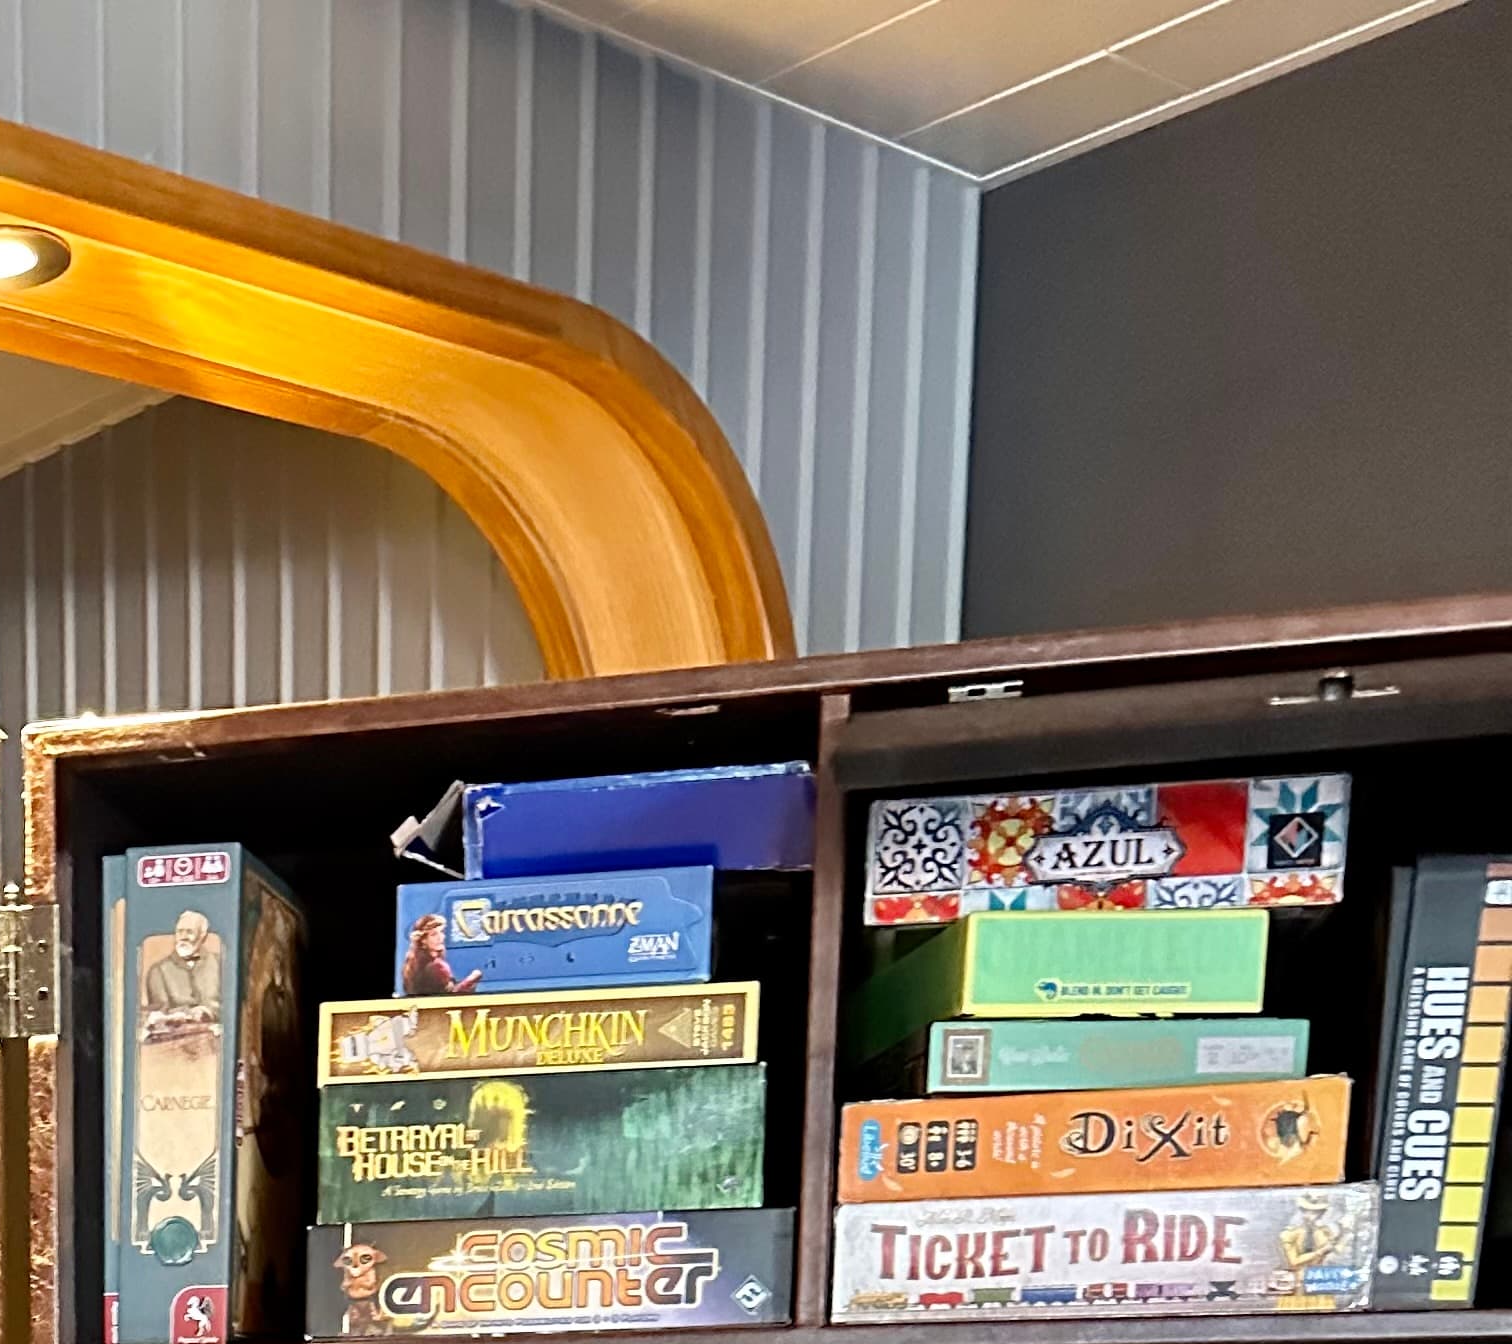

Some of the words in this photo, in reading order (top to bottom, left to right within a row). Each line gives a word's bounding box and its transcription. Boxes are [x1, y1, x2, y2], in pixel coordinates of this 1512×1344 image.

[1051, 838, 1154, 870] AZUL
[455, 900, 644, 940] Carcassonne
[1404, 978, 1424, 1036] GUESSING
[1417, 966, 1471, 1060] HUES
[445, 1008, 651, 1060] MUNCHKIN
[536, 1047, 605, 1066] DELUXE
[1400, 1039, 1417, 1075] GAME
[1418, 1064, 1447, 1104] AND
[337, 1123, 474, 1157] BETRAYAL
[1398, 1109, 1451, 1201] CUES
[353, 1150, 442, 1182] HOUSE
[470, 1147, 536, 1177] HILL
[1383, 1169, 1401, 1201] CLUES
[871, 1222, 1056, 1281] TICKET
[1063, 1226, 1109, 1264] TO
[1122, 1208, 1251, 1265] RIDE
